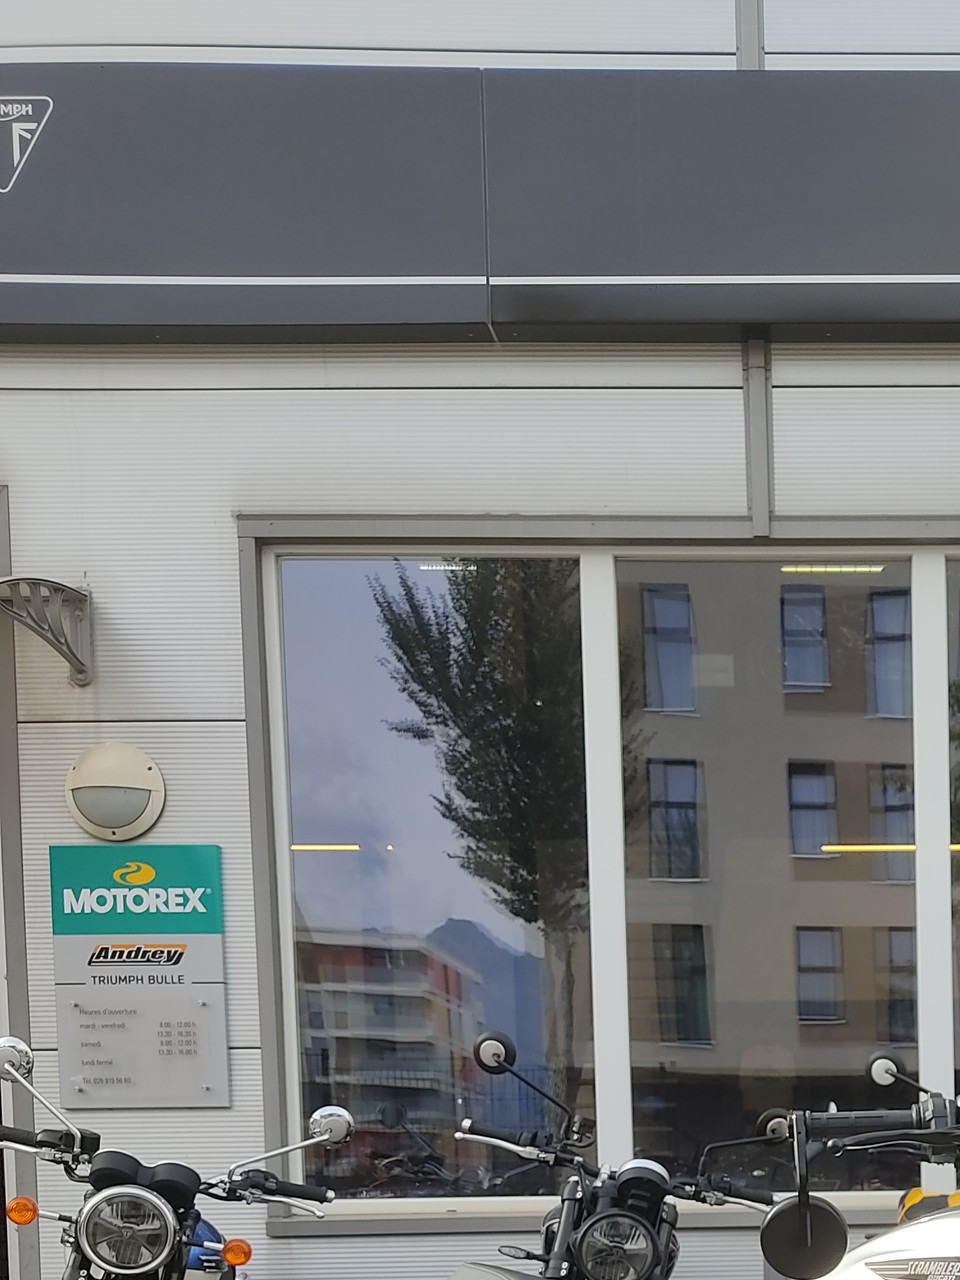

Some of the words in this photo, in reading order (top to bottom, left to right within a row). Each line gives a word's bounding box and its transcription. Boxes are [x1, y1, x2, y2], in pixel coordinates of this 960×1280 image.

[63, 887, 208, 914] MOTOREX
[94, 945, 180, 966] Andrey
[91, 975, 144, 986] TRIUMPH
[148, 975, 185, 985] BULLE
[79, 1008, 101, 1016] Heures
